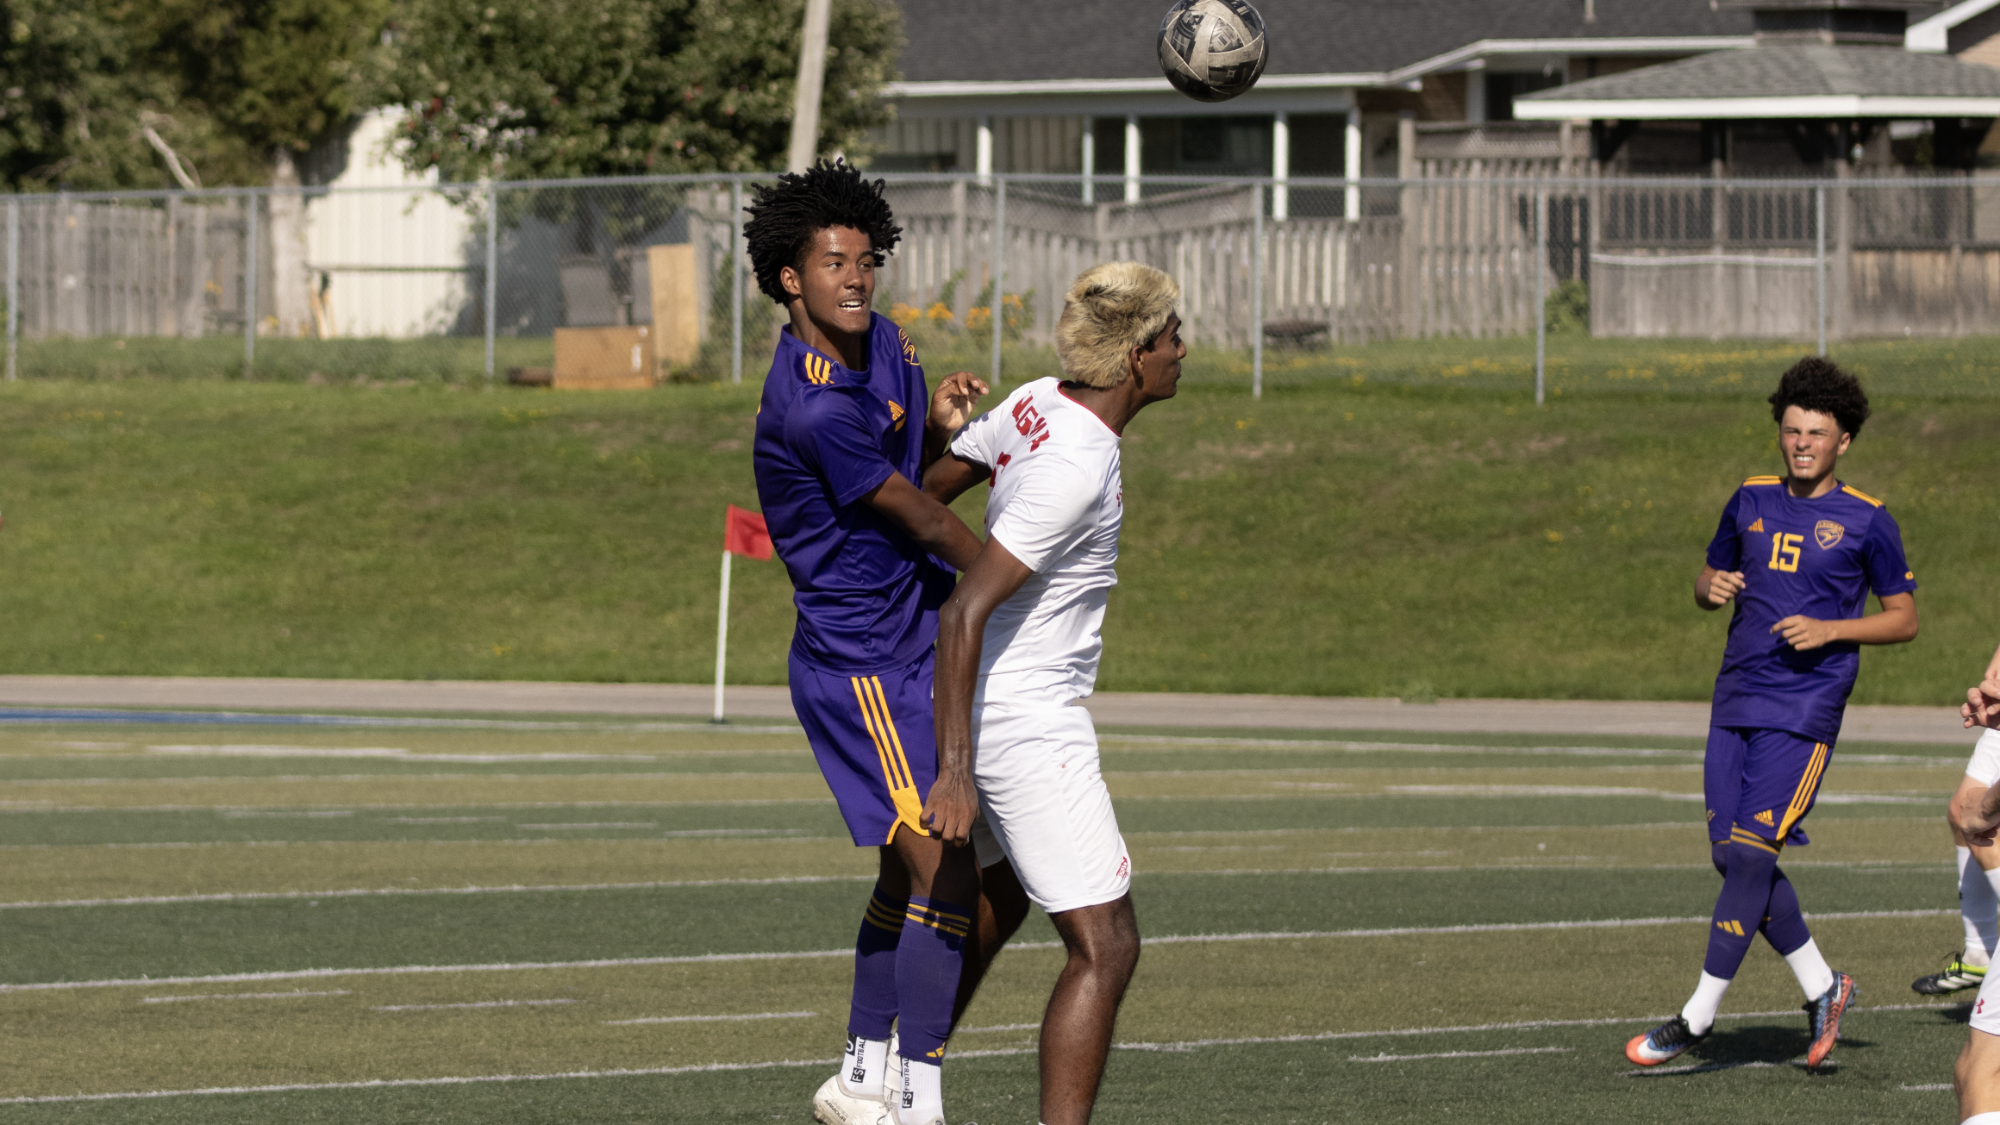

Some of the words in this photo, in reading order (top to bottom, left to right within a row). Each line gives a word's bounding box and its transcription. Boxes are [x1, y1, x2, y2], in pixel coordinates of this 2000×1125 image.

[1769, 532, 1804, 573] 15
[851, 1068, 865, 1082] FS
[903, 1092, 912, 1107] FS
[824, 1099, 847, 1122] ARMOUR
